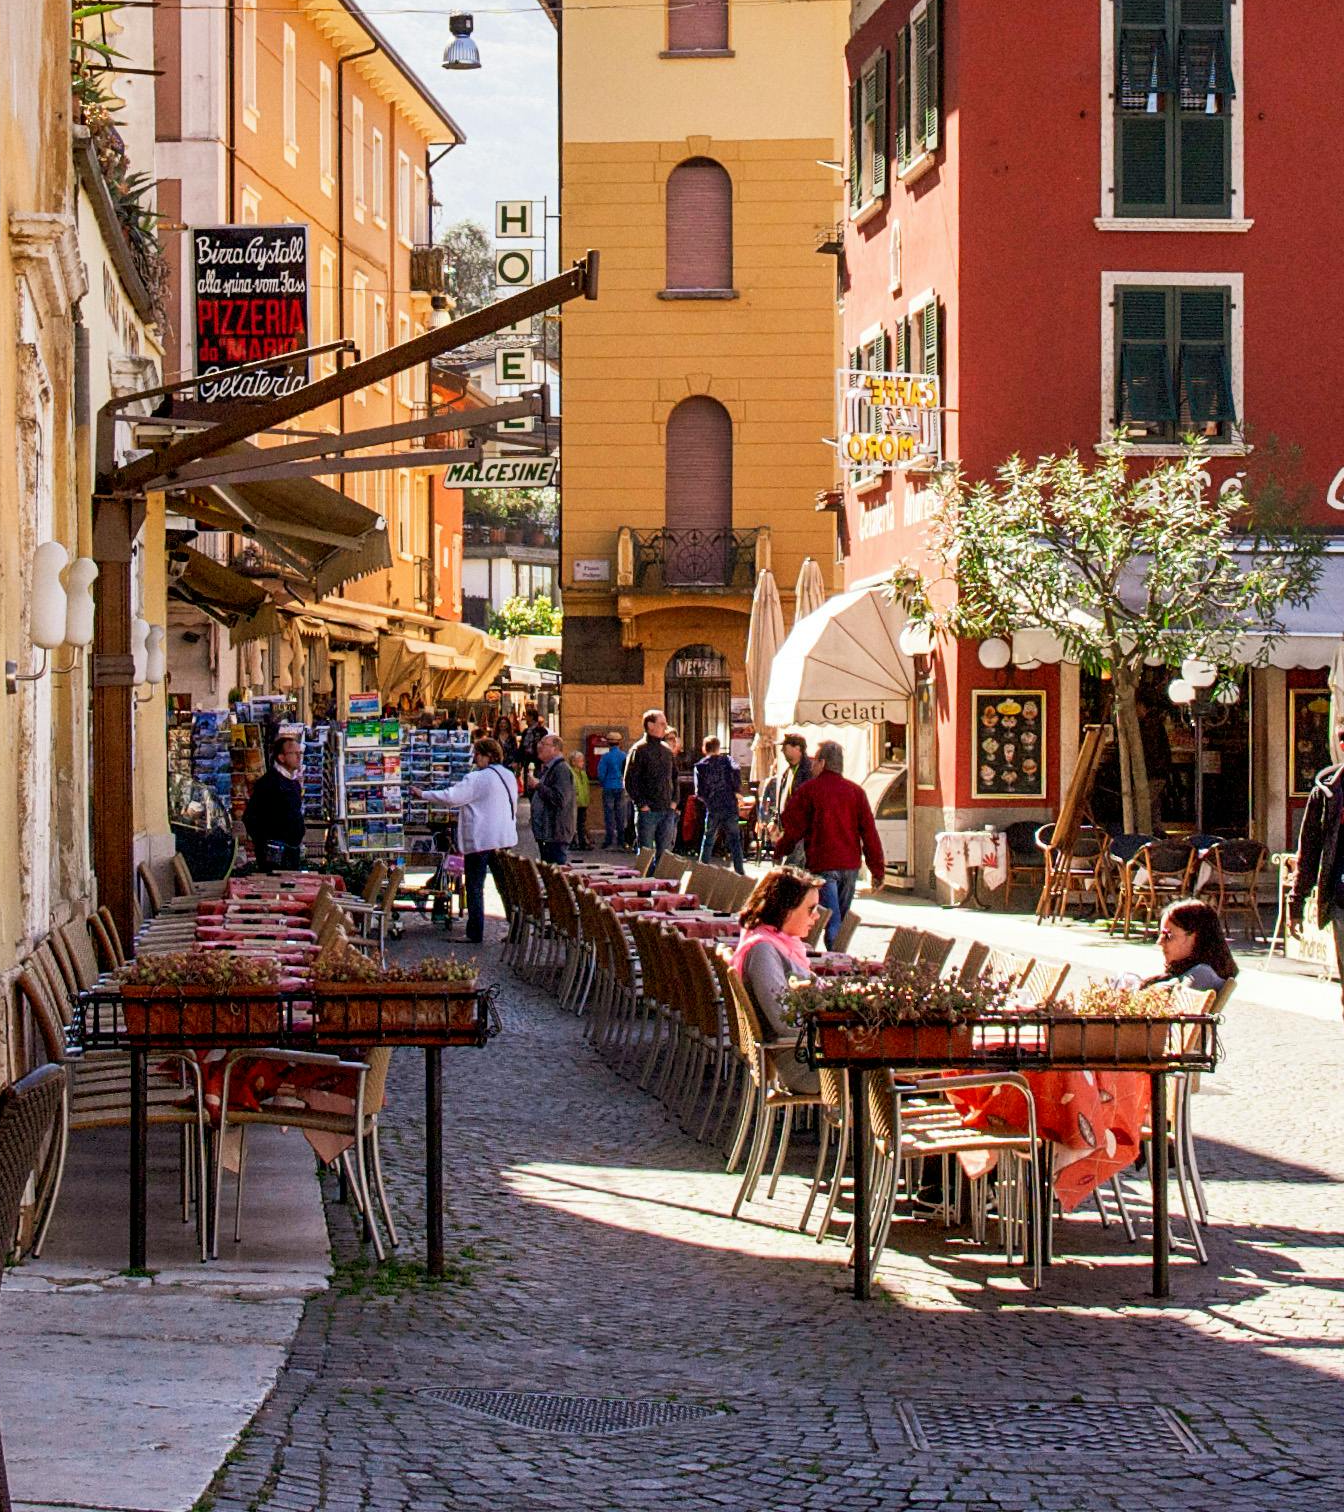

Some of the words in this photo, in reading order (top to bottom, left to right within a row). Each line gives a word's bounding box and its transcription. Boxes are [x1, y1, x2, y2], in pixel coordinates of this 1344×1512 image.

[196, 236, 244, 264] Birra
[197, 269, 222, 294] alla
[198, 299, 305, 335] PIZZERIA
[199, 338, 219, 361] da
[200, 366, 305, 403] Gelateria
[446, 462, 553, 483] MALCESINE
[821, 701, 886, 720] Gelati
